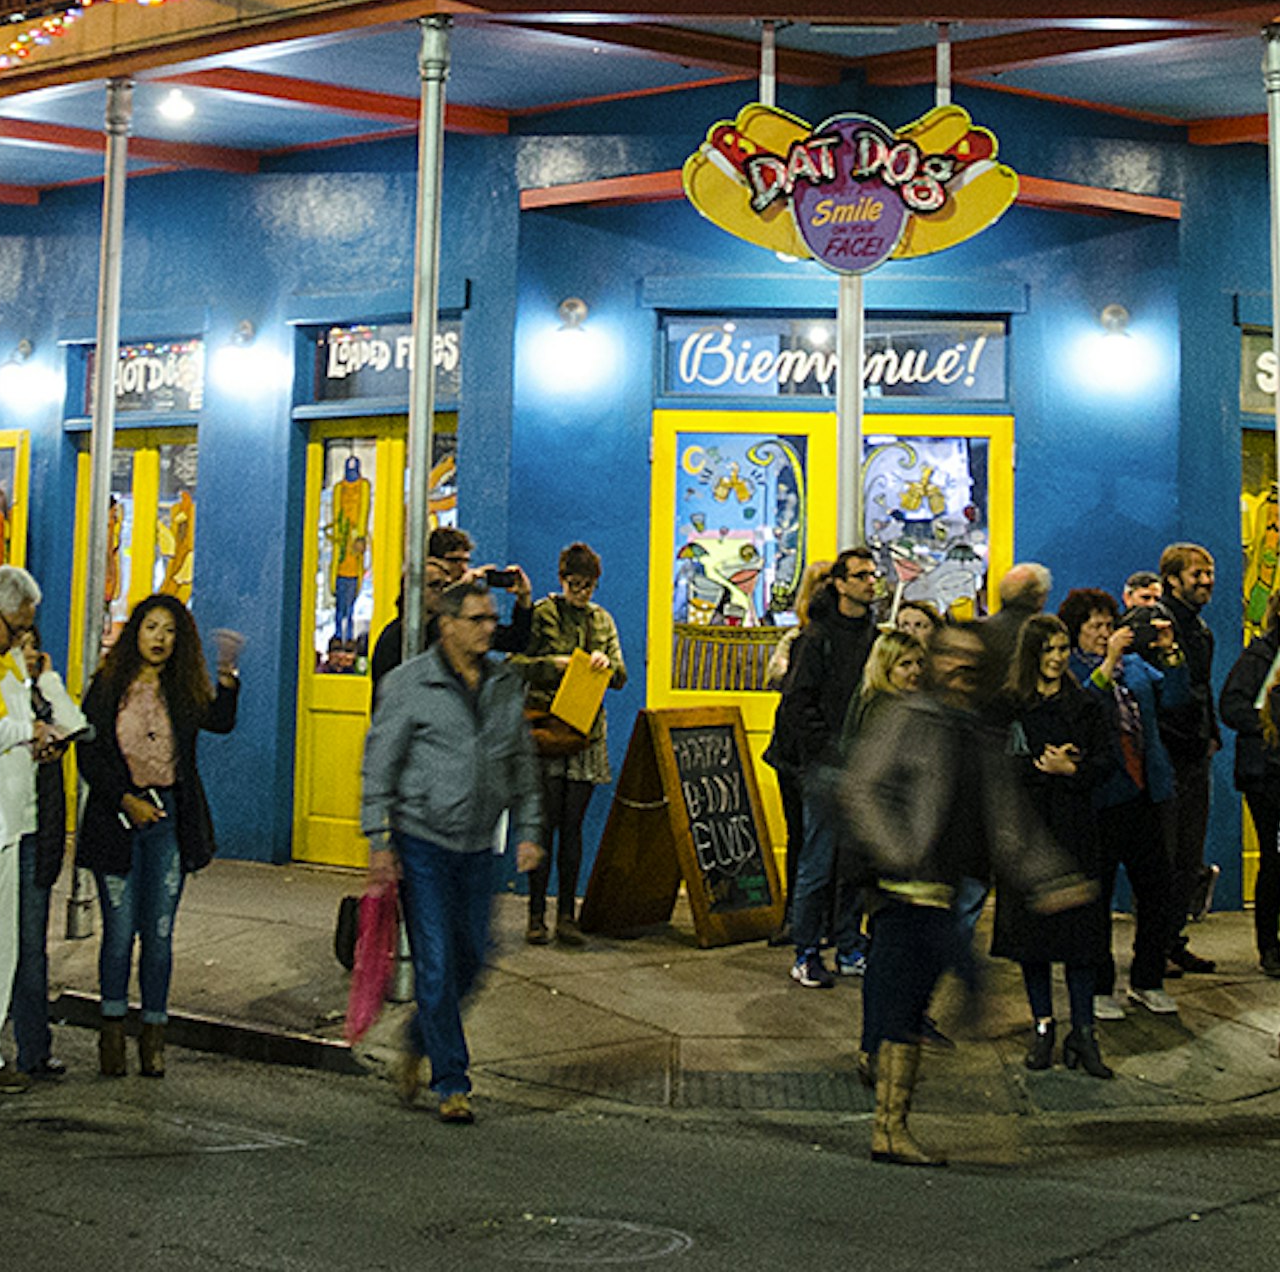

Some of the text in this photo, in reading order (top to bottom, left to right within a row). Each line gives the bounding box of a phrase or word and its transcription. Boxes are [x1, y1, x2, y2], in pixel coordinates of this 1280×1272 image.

[748, 136, 839, 213] DAT
[811, 196, 884, 227] Smile
[824, 236, 884, 257] FACE!
[327, 332, 459, 378] LOADED FES
[679, 324, 987, 388] Bienvnue!
